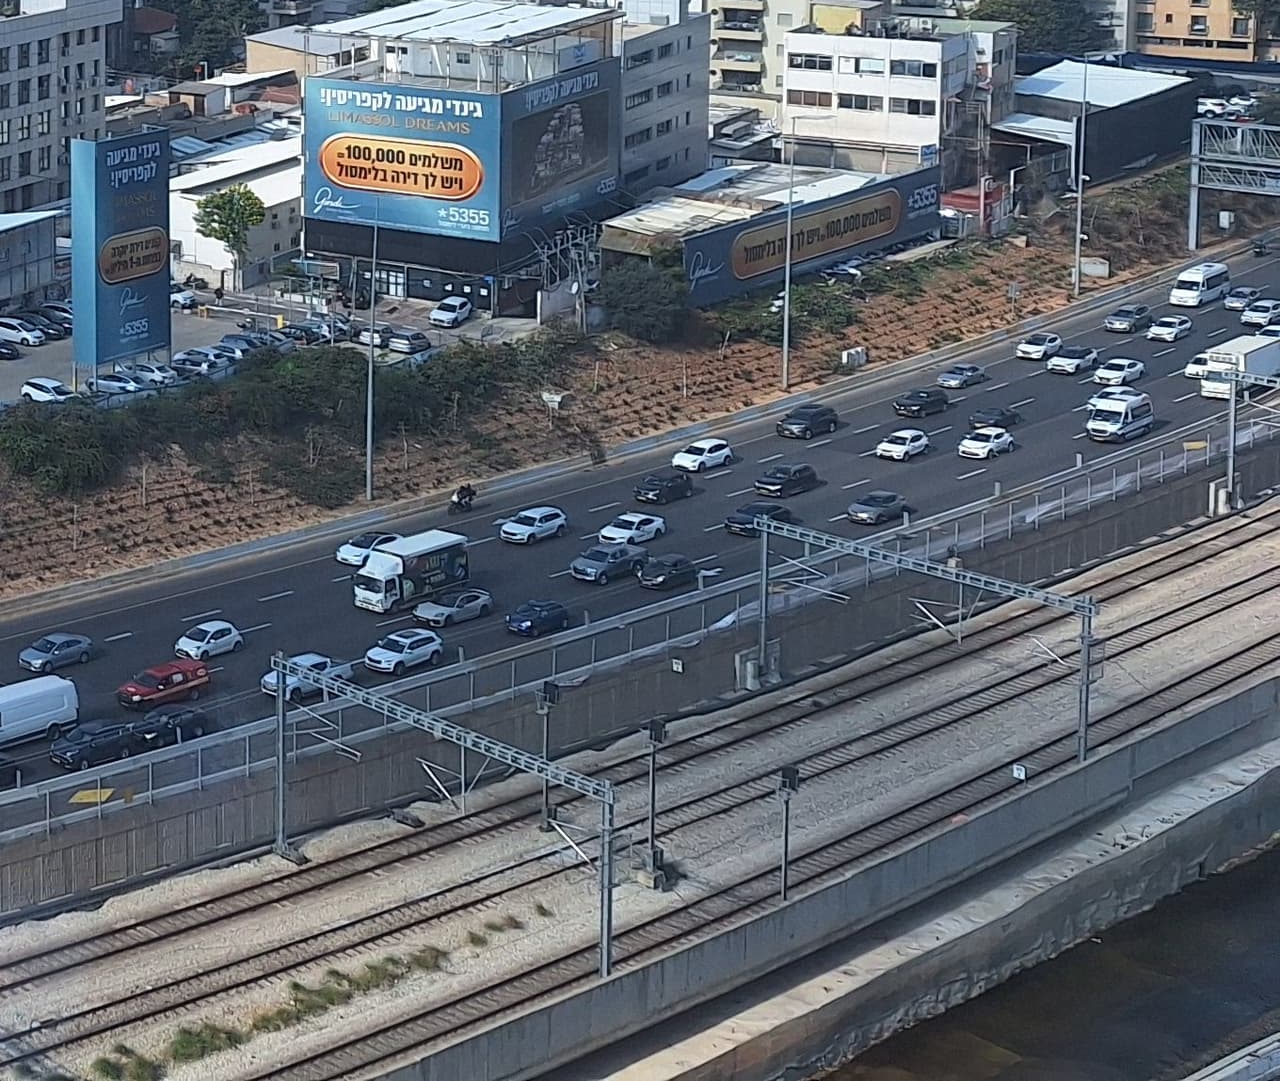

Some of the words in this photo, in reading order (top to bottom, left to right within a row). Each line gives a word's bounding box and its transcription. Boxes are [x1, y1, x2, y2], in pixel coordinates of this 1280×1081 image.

[320, 87, 391, 112] לקפריסין!
[395, 95, 443, 116] מגיעה
[446, 99, 483, 118] גינדי
[405, 116, 471, 135] DREAMS
[106, 147, 137, 167] מגיעה
[138, 142, 160, 159] גינדי
[409, 151, 463, 171] משלמים
[337, 161, 388, 183] בלימסול
[391, 170, 419, 186] דירה
[423, 170, 437, 190] לך
[441, 175, 464, 191] ויש
